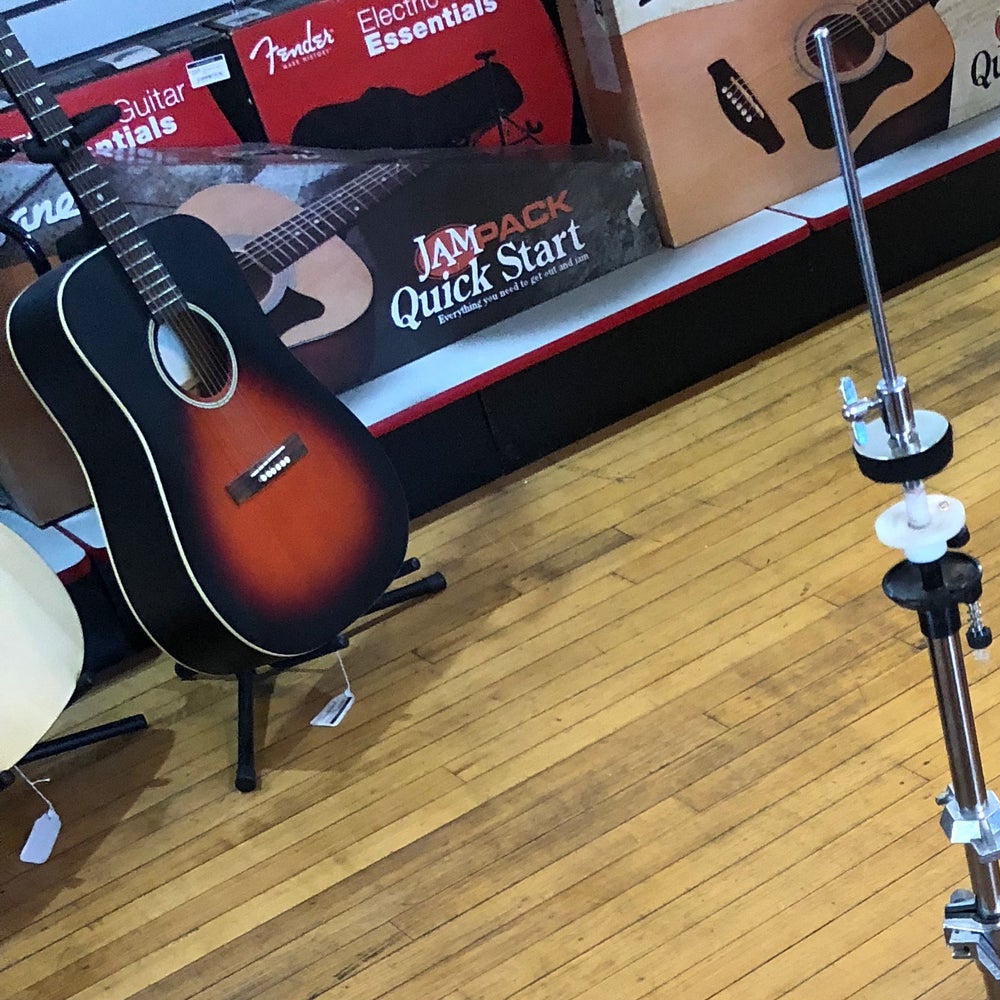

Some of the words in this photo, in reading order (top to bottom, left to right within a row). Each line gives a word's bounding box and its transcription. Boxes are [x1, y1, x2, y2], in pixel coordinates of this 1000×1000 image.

[249, 20, 335, 75] Fender
[364, 0, 498, 57] Essentials
[113, 83, 186, 124] Guitar
[390, 256, 494, 331] Quick
[496, 219, 587, 282] Start
[437, 299, 482, 325] Everything
[483, 294, 499, 308] you
[500, 281, 520, 298] need
[520, 279, 529, 289] to
[531, 272, 543, 286] get
